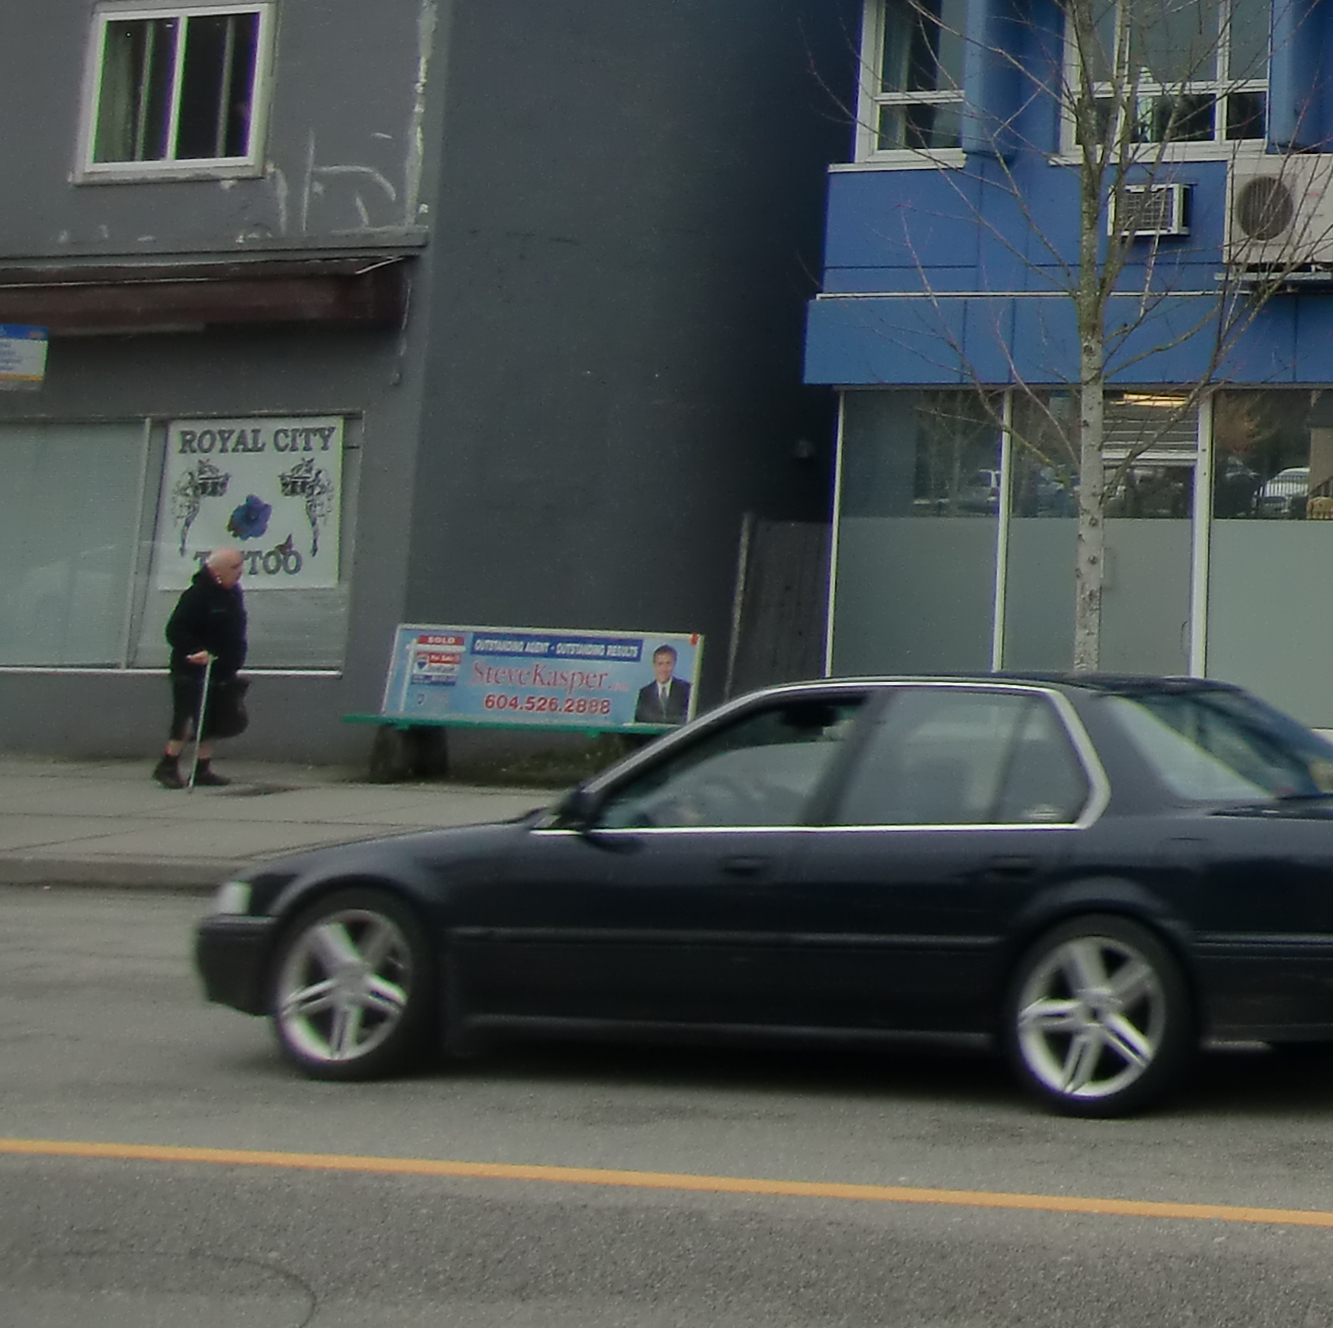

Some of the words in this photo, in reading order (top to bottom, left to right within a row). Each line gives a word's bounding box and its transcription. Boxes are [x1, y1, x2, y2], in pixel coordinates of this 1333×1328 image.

[178, 429, 266, 454] ROYAL
[273, 426, 337, 452] CITY
[192, 549, 303, 576] TTOO
[475, 639, 524, 652] OUTSTANDING
[524, 641, 550, 653] AGENT
[556, 642, 605, 656] OUTSTANDING
[606, 644, 639, 658] RESULTS
[485, 693, 611, 715] 604.526.2888
